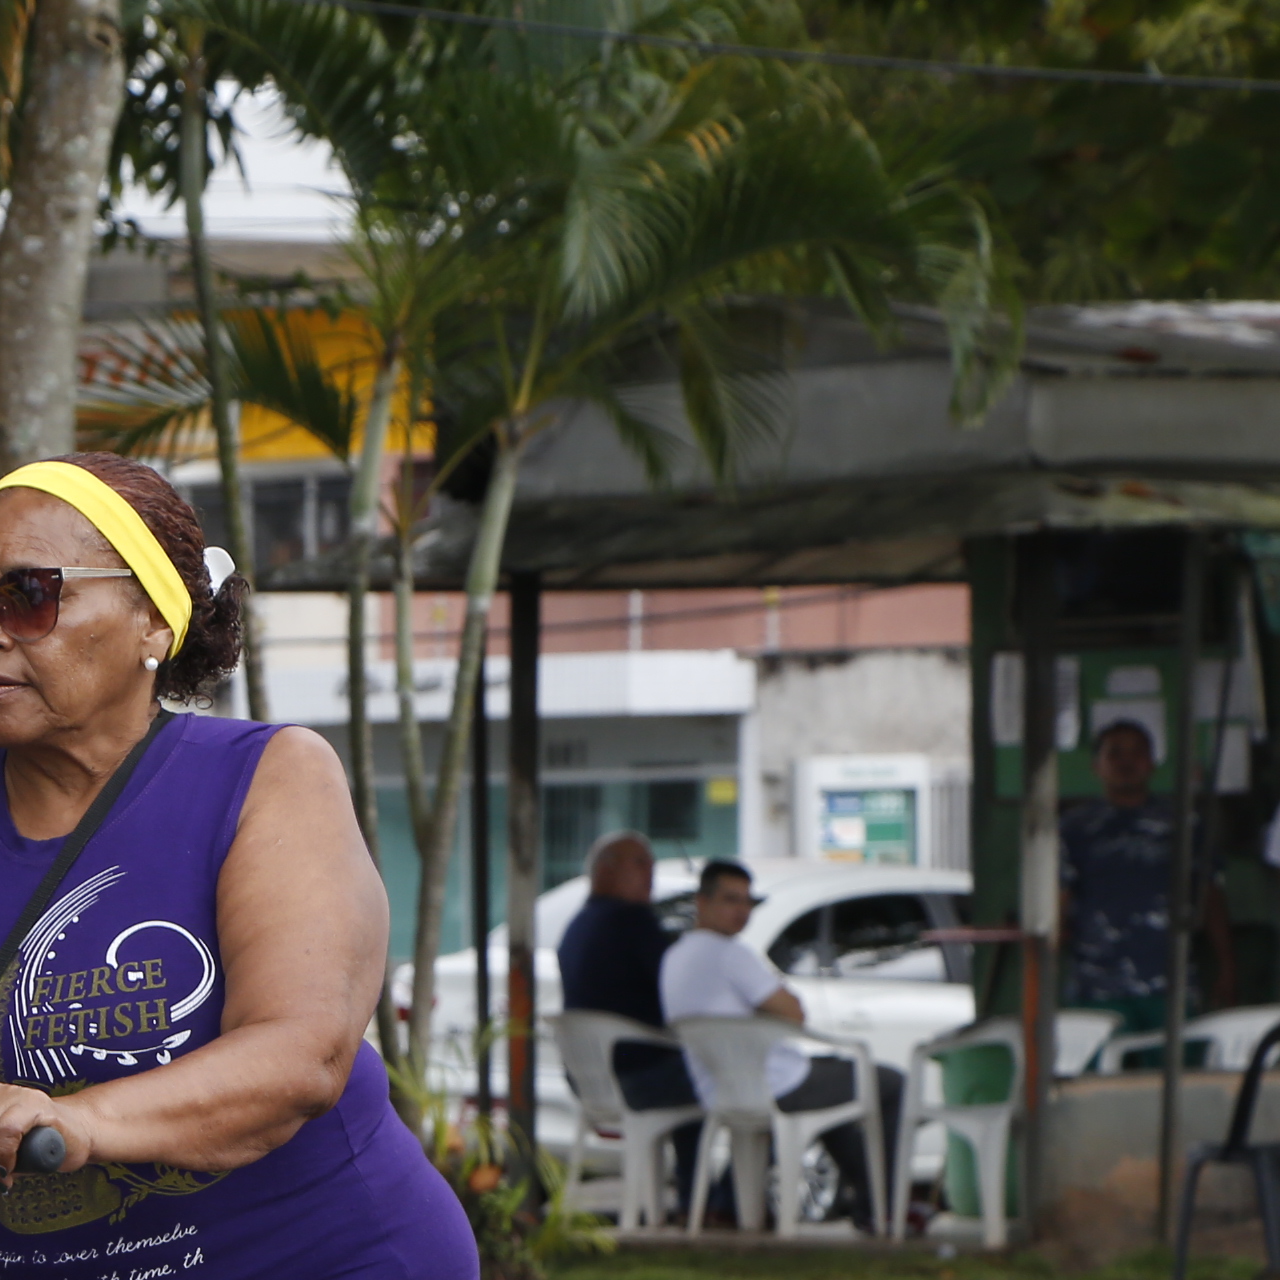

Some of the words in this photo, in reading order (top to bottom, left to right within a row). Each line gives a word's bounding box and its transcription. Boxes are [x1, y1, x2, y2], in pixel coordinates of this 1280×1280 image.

[30, 958, 167, 1006] FIERCE
[23, 998, 170, 1049] FETISH
[106, 1222, 198, 1256] themselve
[183, 1246, 204, 1269] th
